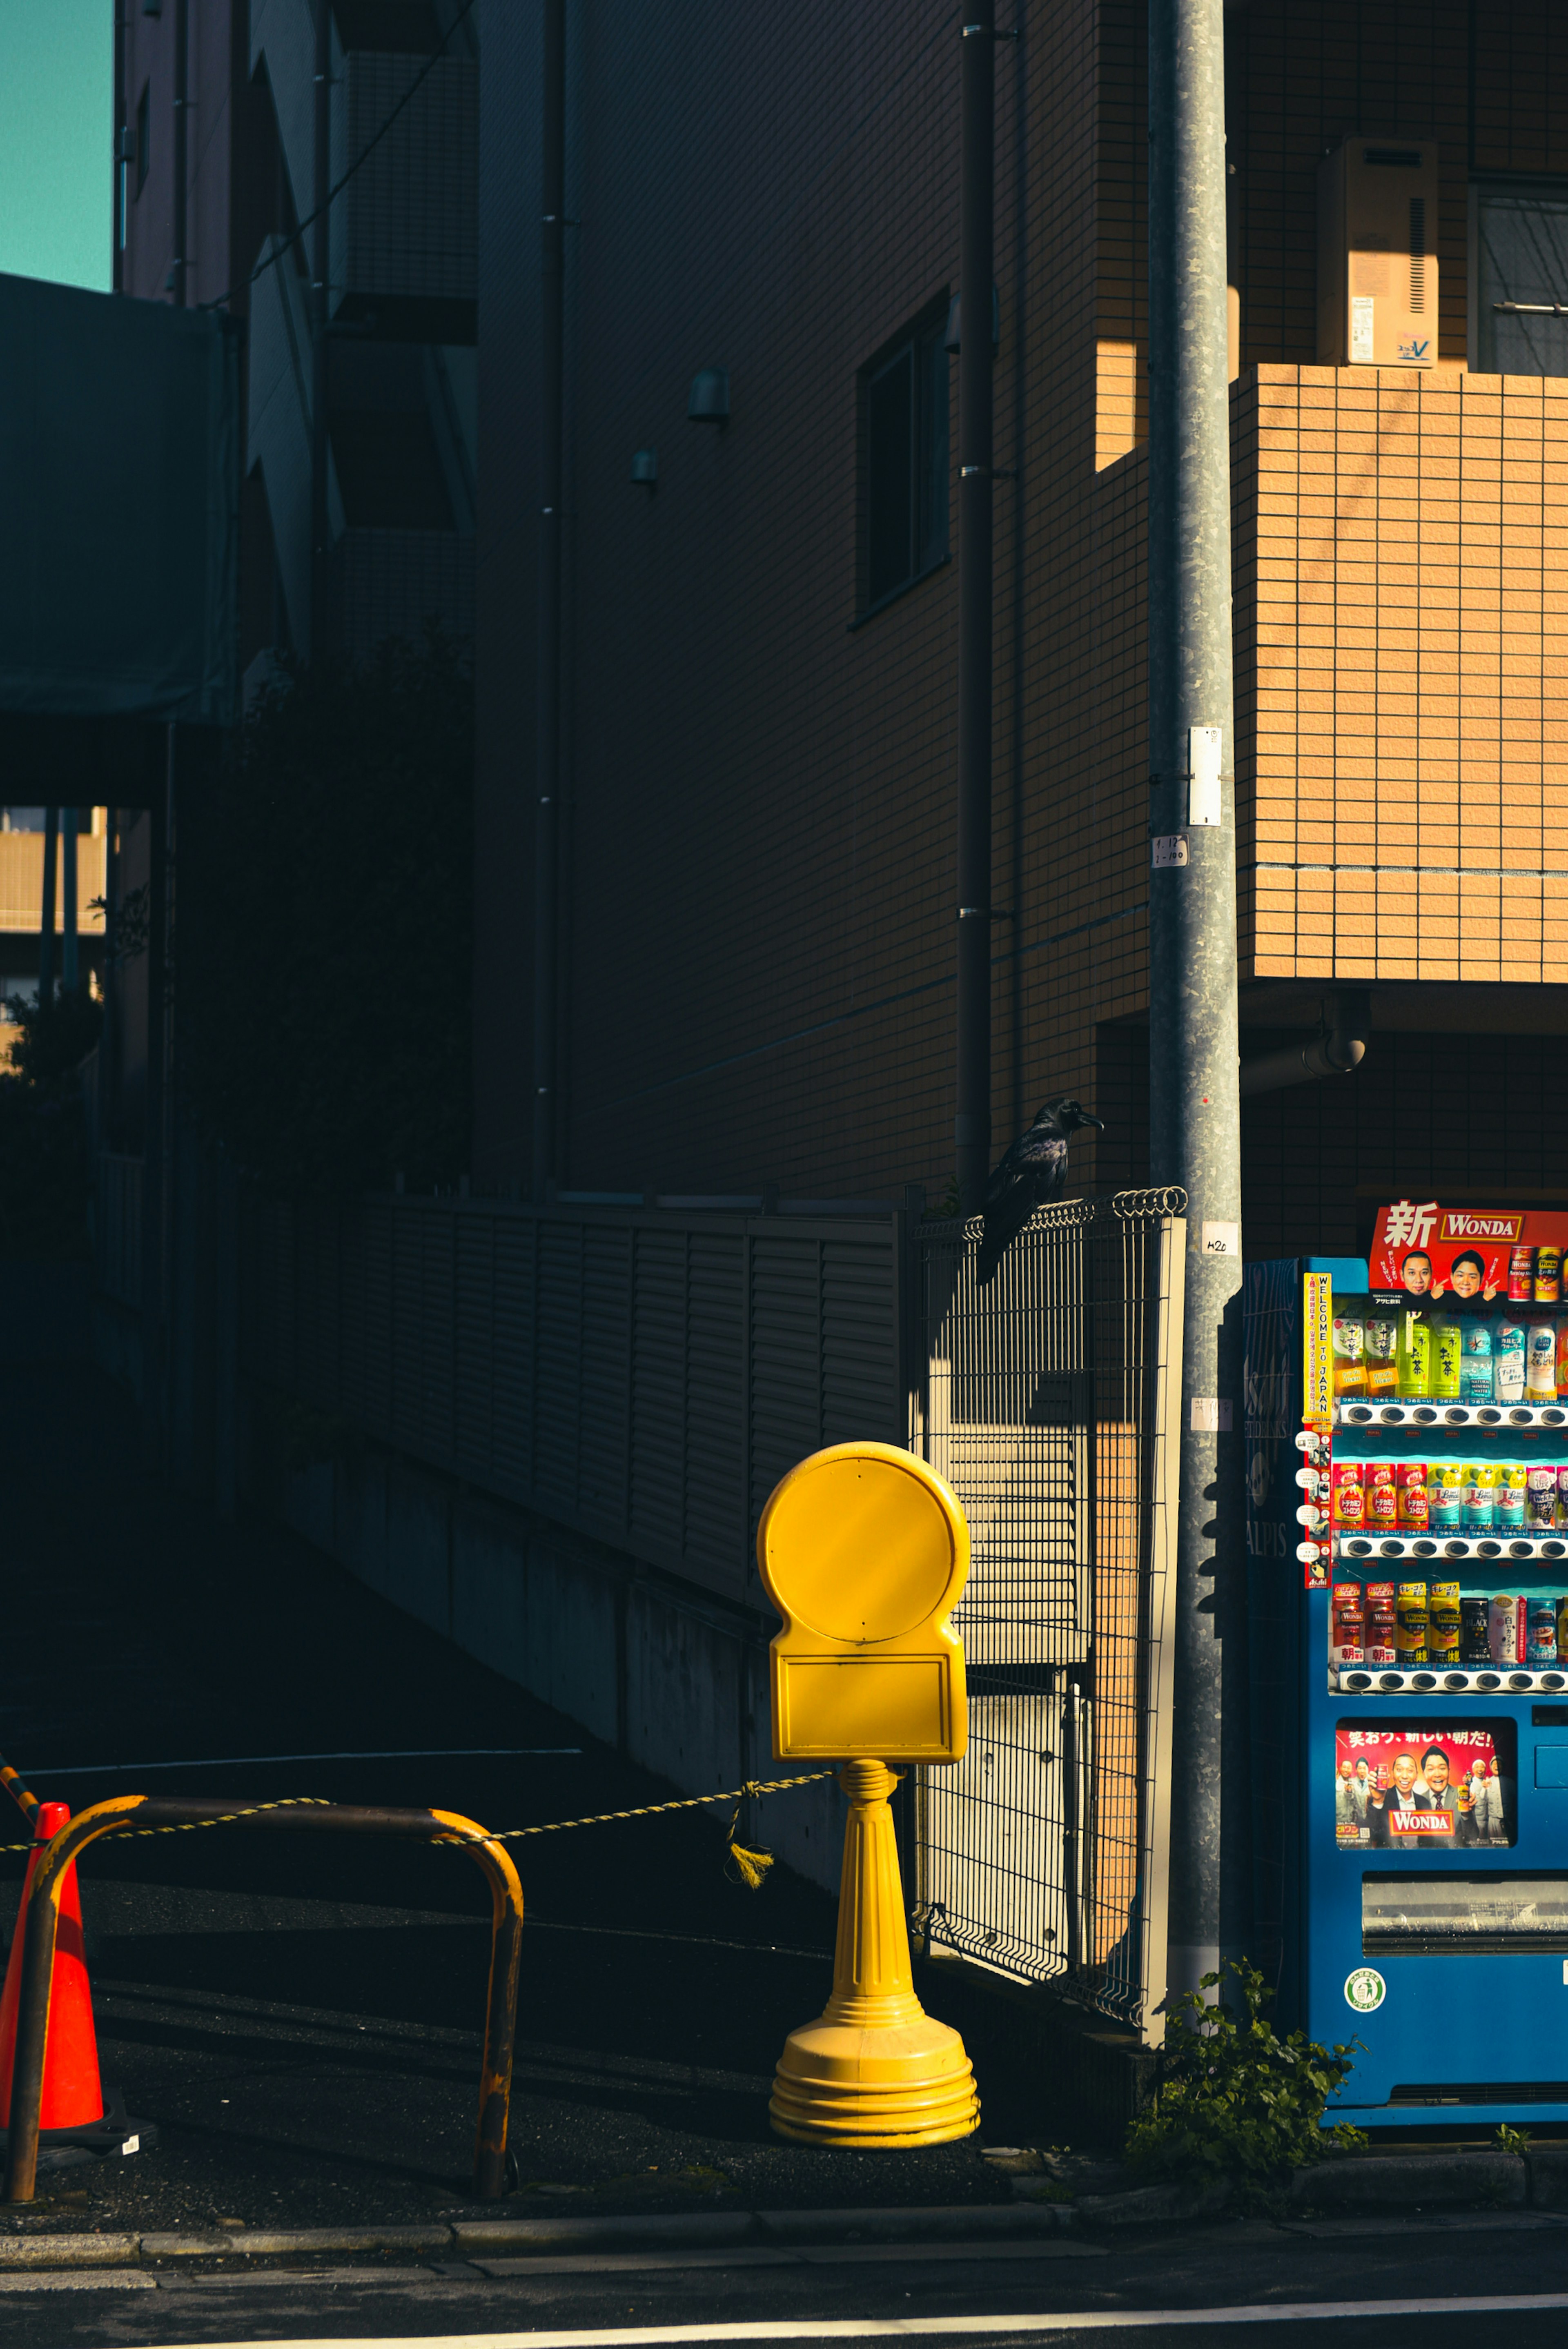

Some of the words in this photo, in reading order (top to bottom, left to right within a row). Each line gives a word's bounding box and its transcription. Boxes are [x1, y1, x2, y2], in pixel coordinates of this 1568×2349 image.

[1384, 1200, 1437, 1248] 新
[1448, 1214, 1514, 1236] WONDA
[1319, 1276, 1327, 1340] WELCOME
[1347, 1328, 1357, 1355] 十六茶
[1379, 1329, 1389, 1356] 十六茶
[1320, 1347, 1326, 1361] TO
[1256, 1421, 1287, 1438] DRINKS
[1399, 1584, 1423, 1592] キレ・コク
[1432, 1584, 1457, 1593] キレ・コク
[1466, 1619, 1487, 1627] BLACK
[1341, 1648, 1354, 1660] 朝
[1372, 1649, 1385, 1661] 朝
[1393, 1811, 1448, 1830] WONDA
[1353, 1998, 1379, 2009] リサイクル
